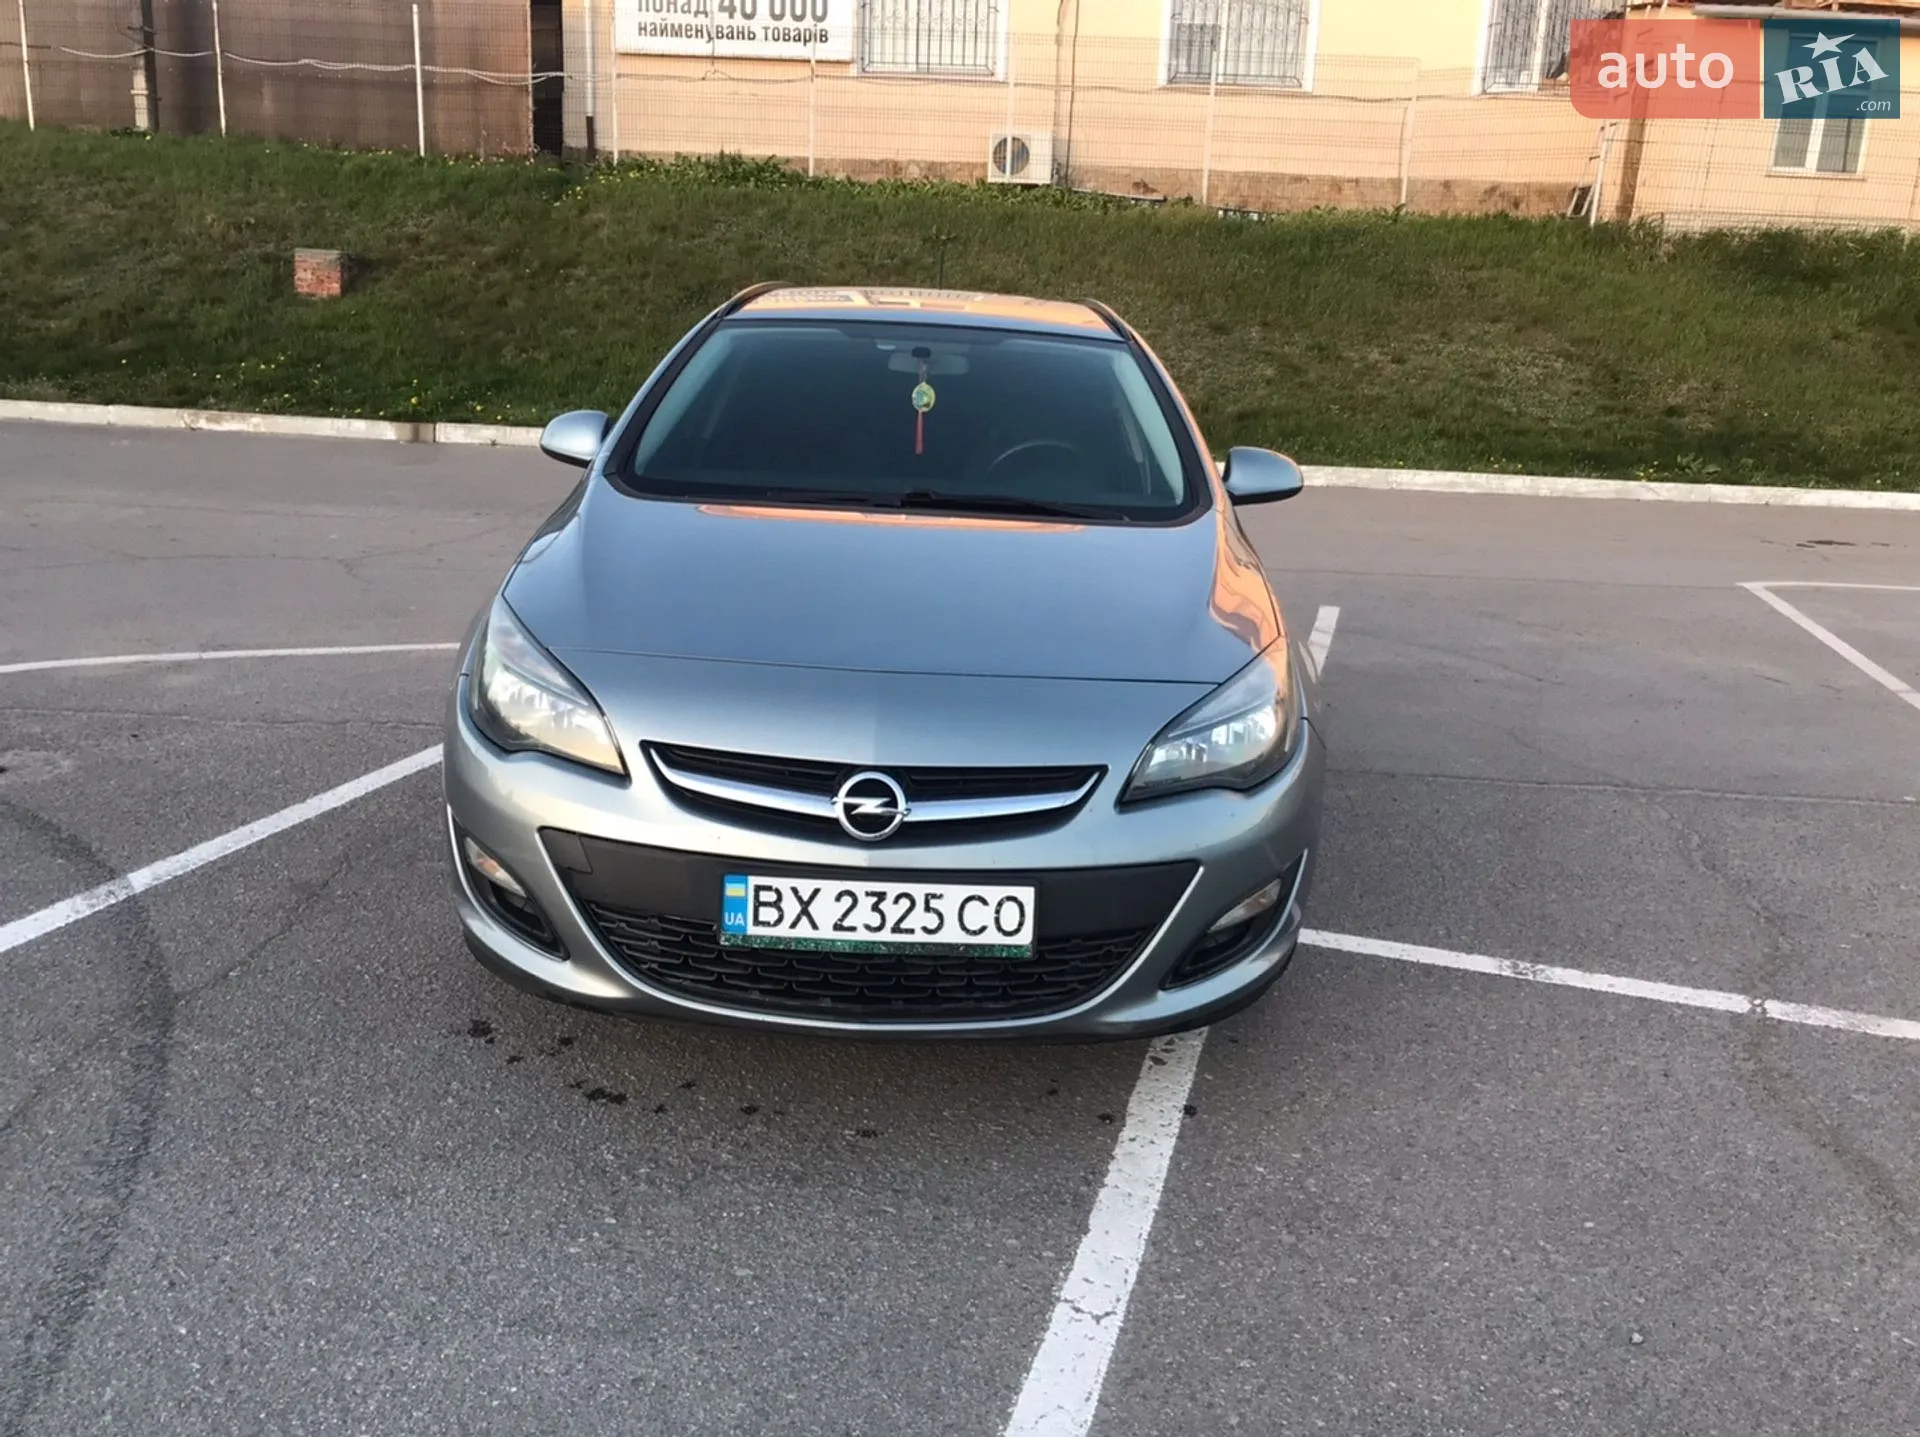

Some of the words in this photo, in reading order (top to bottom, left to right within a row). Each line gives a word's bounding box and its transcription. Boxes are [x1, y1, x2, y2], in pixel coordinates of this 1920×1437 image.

[638, 18, 757, 43] найменувань
[762, 24, 829, 46] товарів
[725, 911, 745, 926] UA
[752, 884, 821, 931] BX
[832, 889, 944, 935] 2325
[957, 894, 1026, 937] CO
